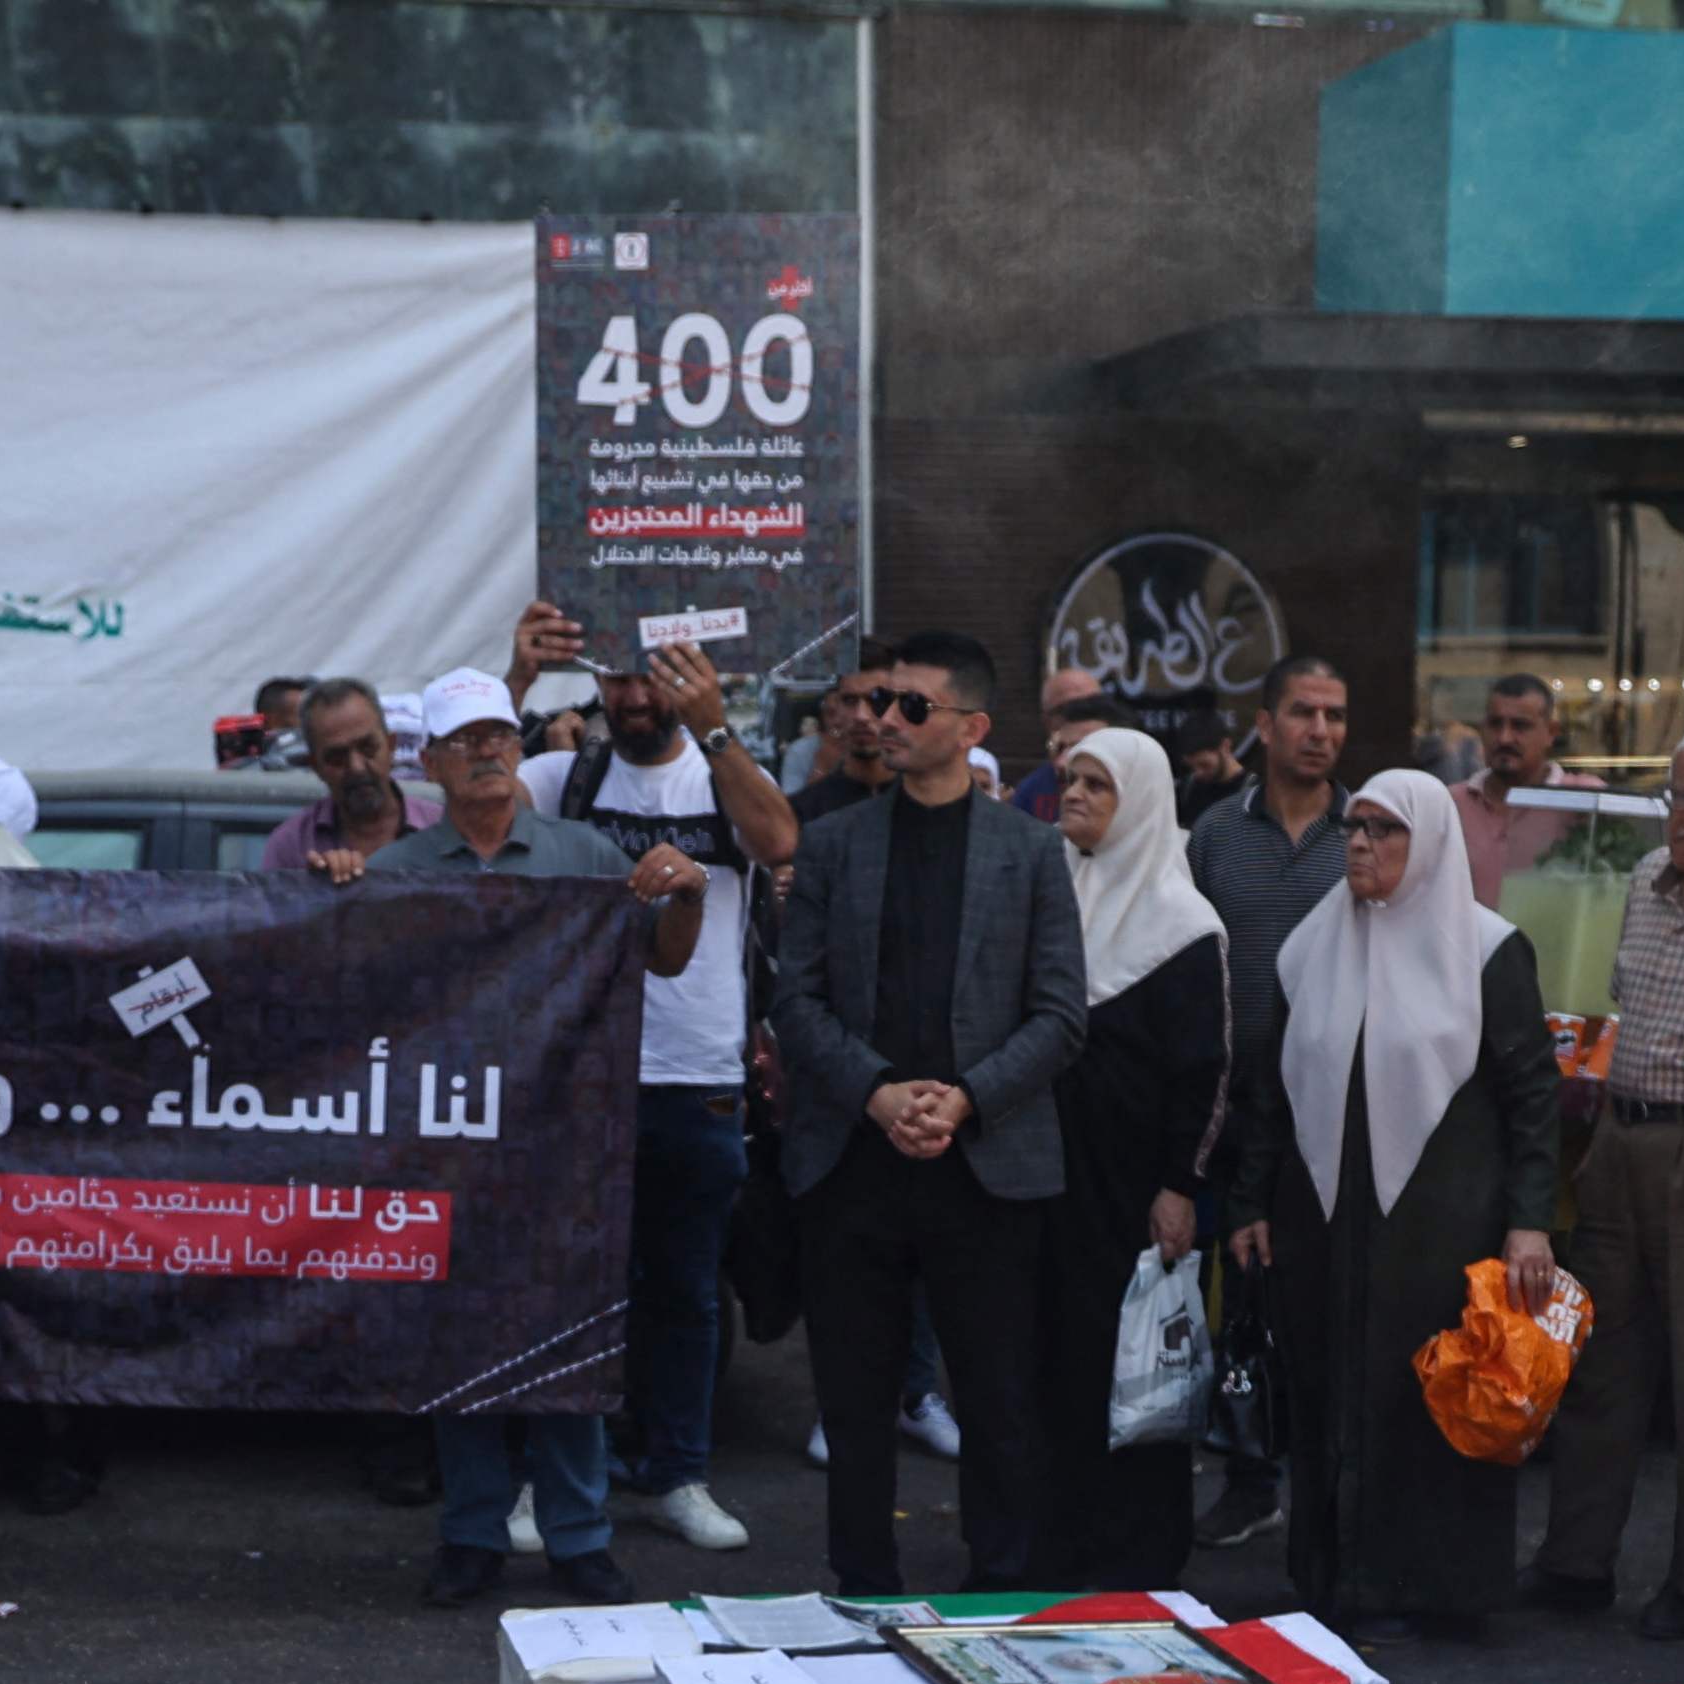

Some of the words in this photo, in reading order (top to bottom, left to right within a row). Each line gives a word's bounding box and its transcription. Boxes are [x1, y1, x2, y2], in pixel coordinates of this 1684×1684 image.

[576, 312, 814, 429] 400
[588, 438, 656, 463] محرومة
[660, 435, 757, 462] فلسطينية
[760, 435, 805, 459] عائلة
[696, 472, 729, 496] في
[733, 468, 773, 495] حقها
[776, 472, 805, 492] من
[588, 501, 703, 534] المحتجزين
[707, 501, 805, 536] الشهداء
[589, 544, 654, 568] الاحتلال
[657, 544, 722, 567] وثلاجات
[724, 545, 769, 568] مقابر
[772, 547, 805, 572] في
[147, 1036, 390, 1135] أسماء
[419, 1063, 501, 1141] لنا
[11, 1176, 119, 1214] جثامين
[131, 1186, 251, 1220] نستعيد
[260, 1177, 296, 1225] أن
[308, 1182, 363, 1220] لنا
[374, 1188, 440, 1232] حق
[5, 1228, 154, 1271] بكرامتهم
[162, 1234, 234, 1275] يليق
[243, 1235, 287, 1273] بما
[297, 1241, 439, 1281] وندفنهم
